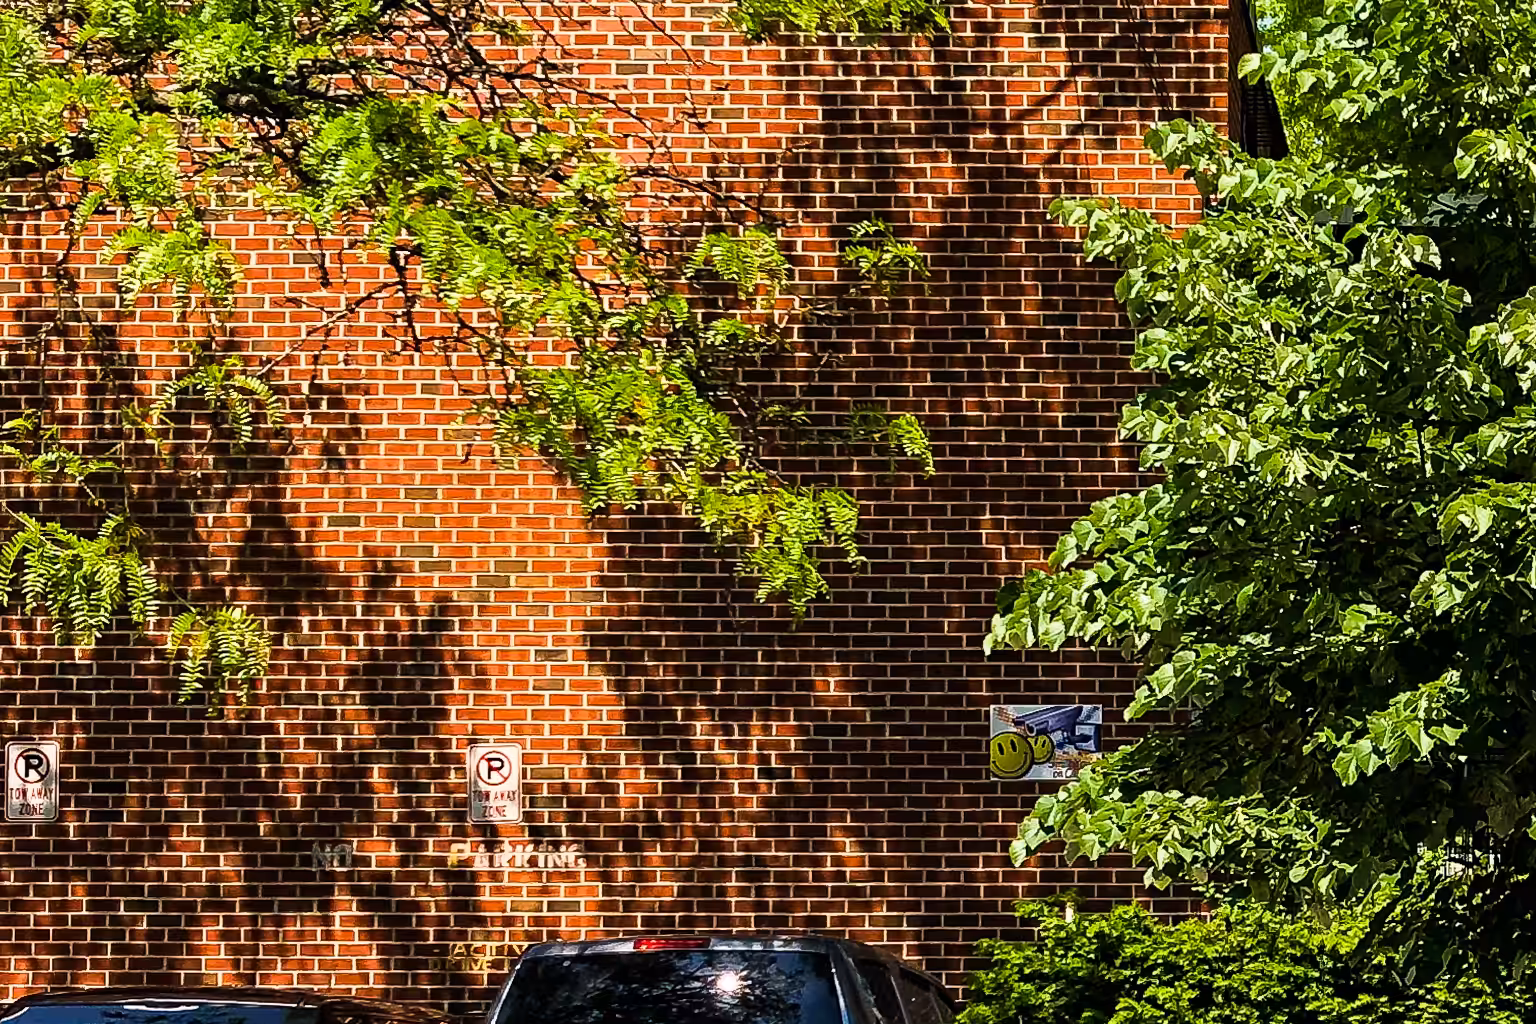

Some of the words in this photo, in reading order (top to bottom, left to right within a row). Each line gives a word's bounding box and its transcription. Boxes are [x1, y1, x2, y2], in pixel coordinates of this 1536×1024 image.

[9, 788, 28, 800] TOW
[31, 788, 54, 800] AWAY
[19, 803, 44, 815] ZONE
[447, 841, 587, 869] PARKING
[453, 944, 529, 957] ACTIV
